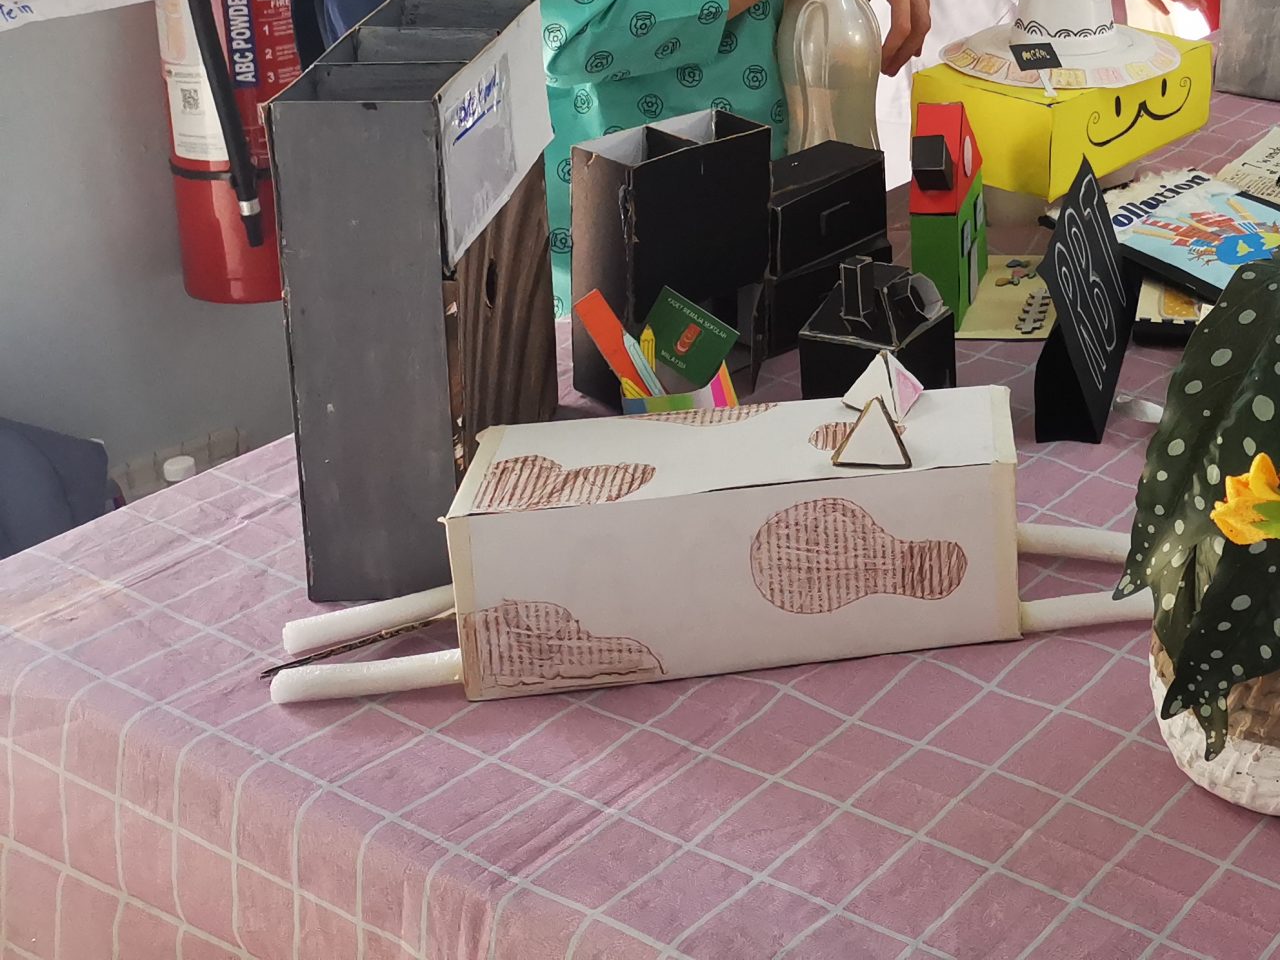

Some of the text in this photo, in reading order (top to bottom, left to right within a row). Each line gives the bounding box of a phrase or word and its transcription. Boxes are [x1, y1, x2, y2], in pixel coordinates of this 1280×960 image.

[263, 25, 270, 36] 1
[265, 50, 273, 60] 2
[233, 53, 256, 83] ABC
[1112, 171, 1211, 228] ollution
